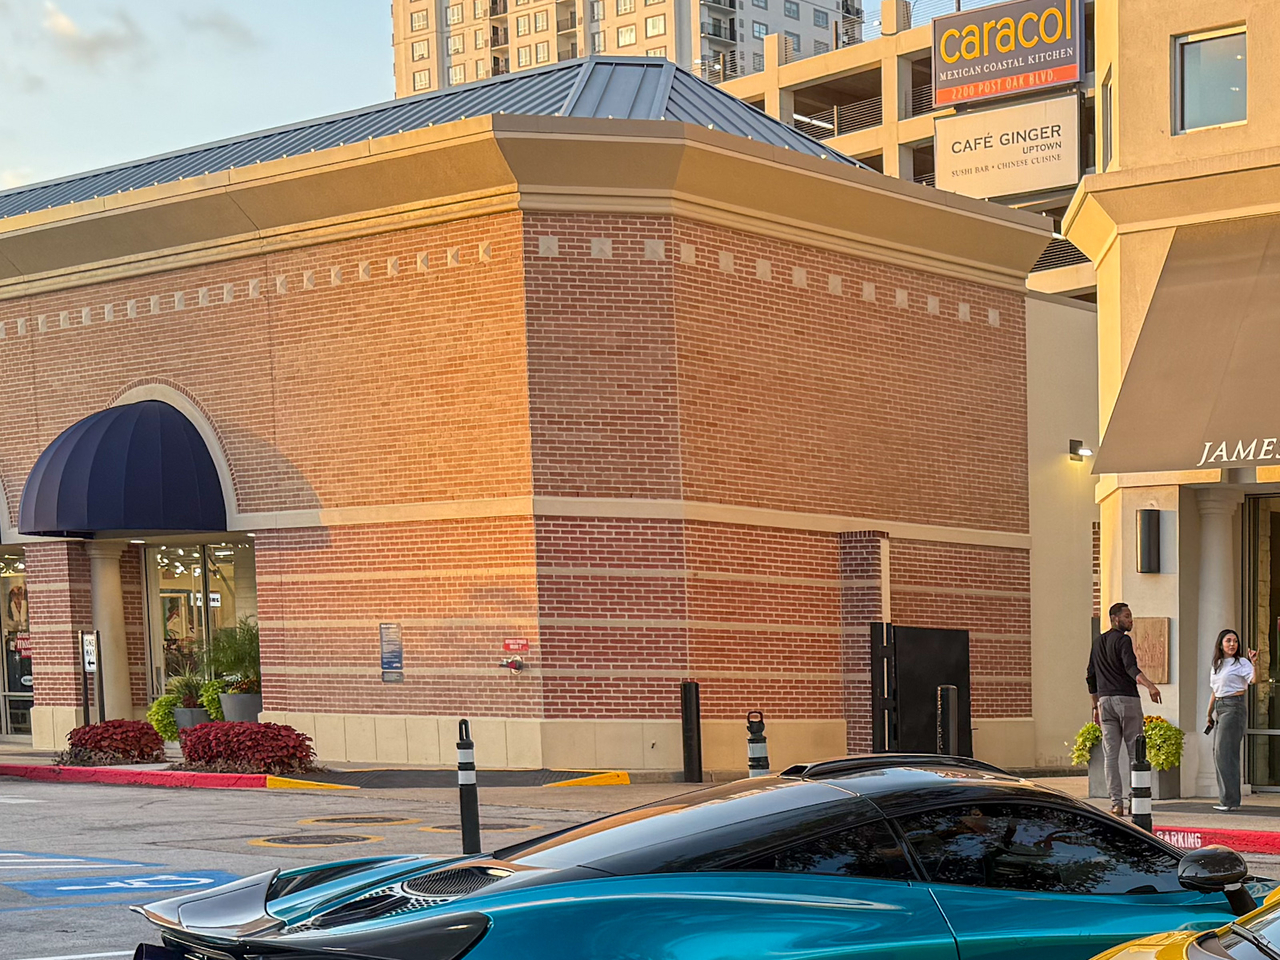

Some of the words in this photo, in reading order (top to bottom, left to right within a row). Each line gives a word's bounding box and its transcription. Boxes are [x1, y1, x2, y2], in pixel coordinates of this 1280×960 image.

[940, 0, 1072, 63] caracol
[940, 65, 982, 81] MEXICAN
[983, 57, 1025, 73] COASTAL
[1028, 47, 1074, 64] KITCHEN
[951, 85, 975, 100] 2200
[978, 79, 1002, 95] POST
[1006, 75, 1025, 90] OAK
[951, 132, 993, 154] CAFÉ
[999, 124, 1062, 146] GINGER
[1022, 141, 1062, 155] UPTOWN
[951, 166, 973, 177] SUSHI
[975, 164, 990, 174] BAR
[997, 158, 1029, 170] CHINESE
[1031, 153, 1062, 166] CUISINE
